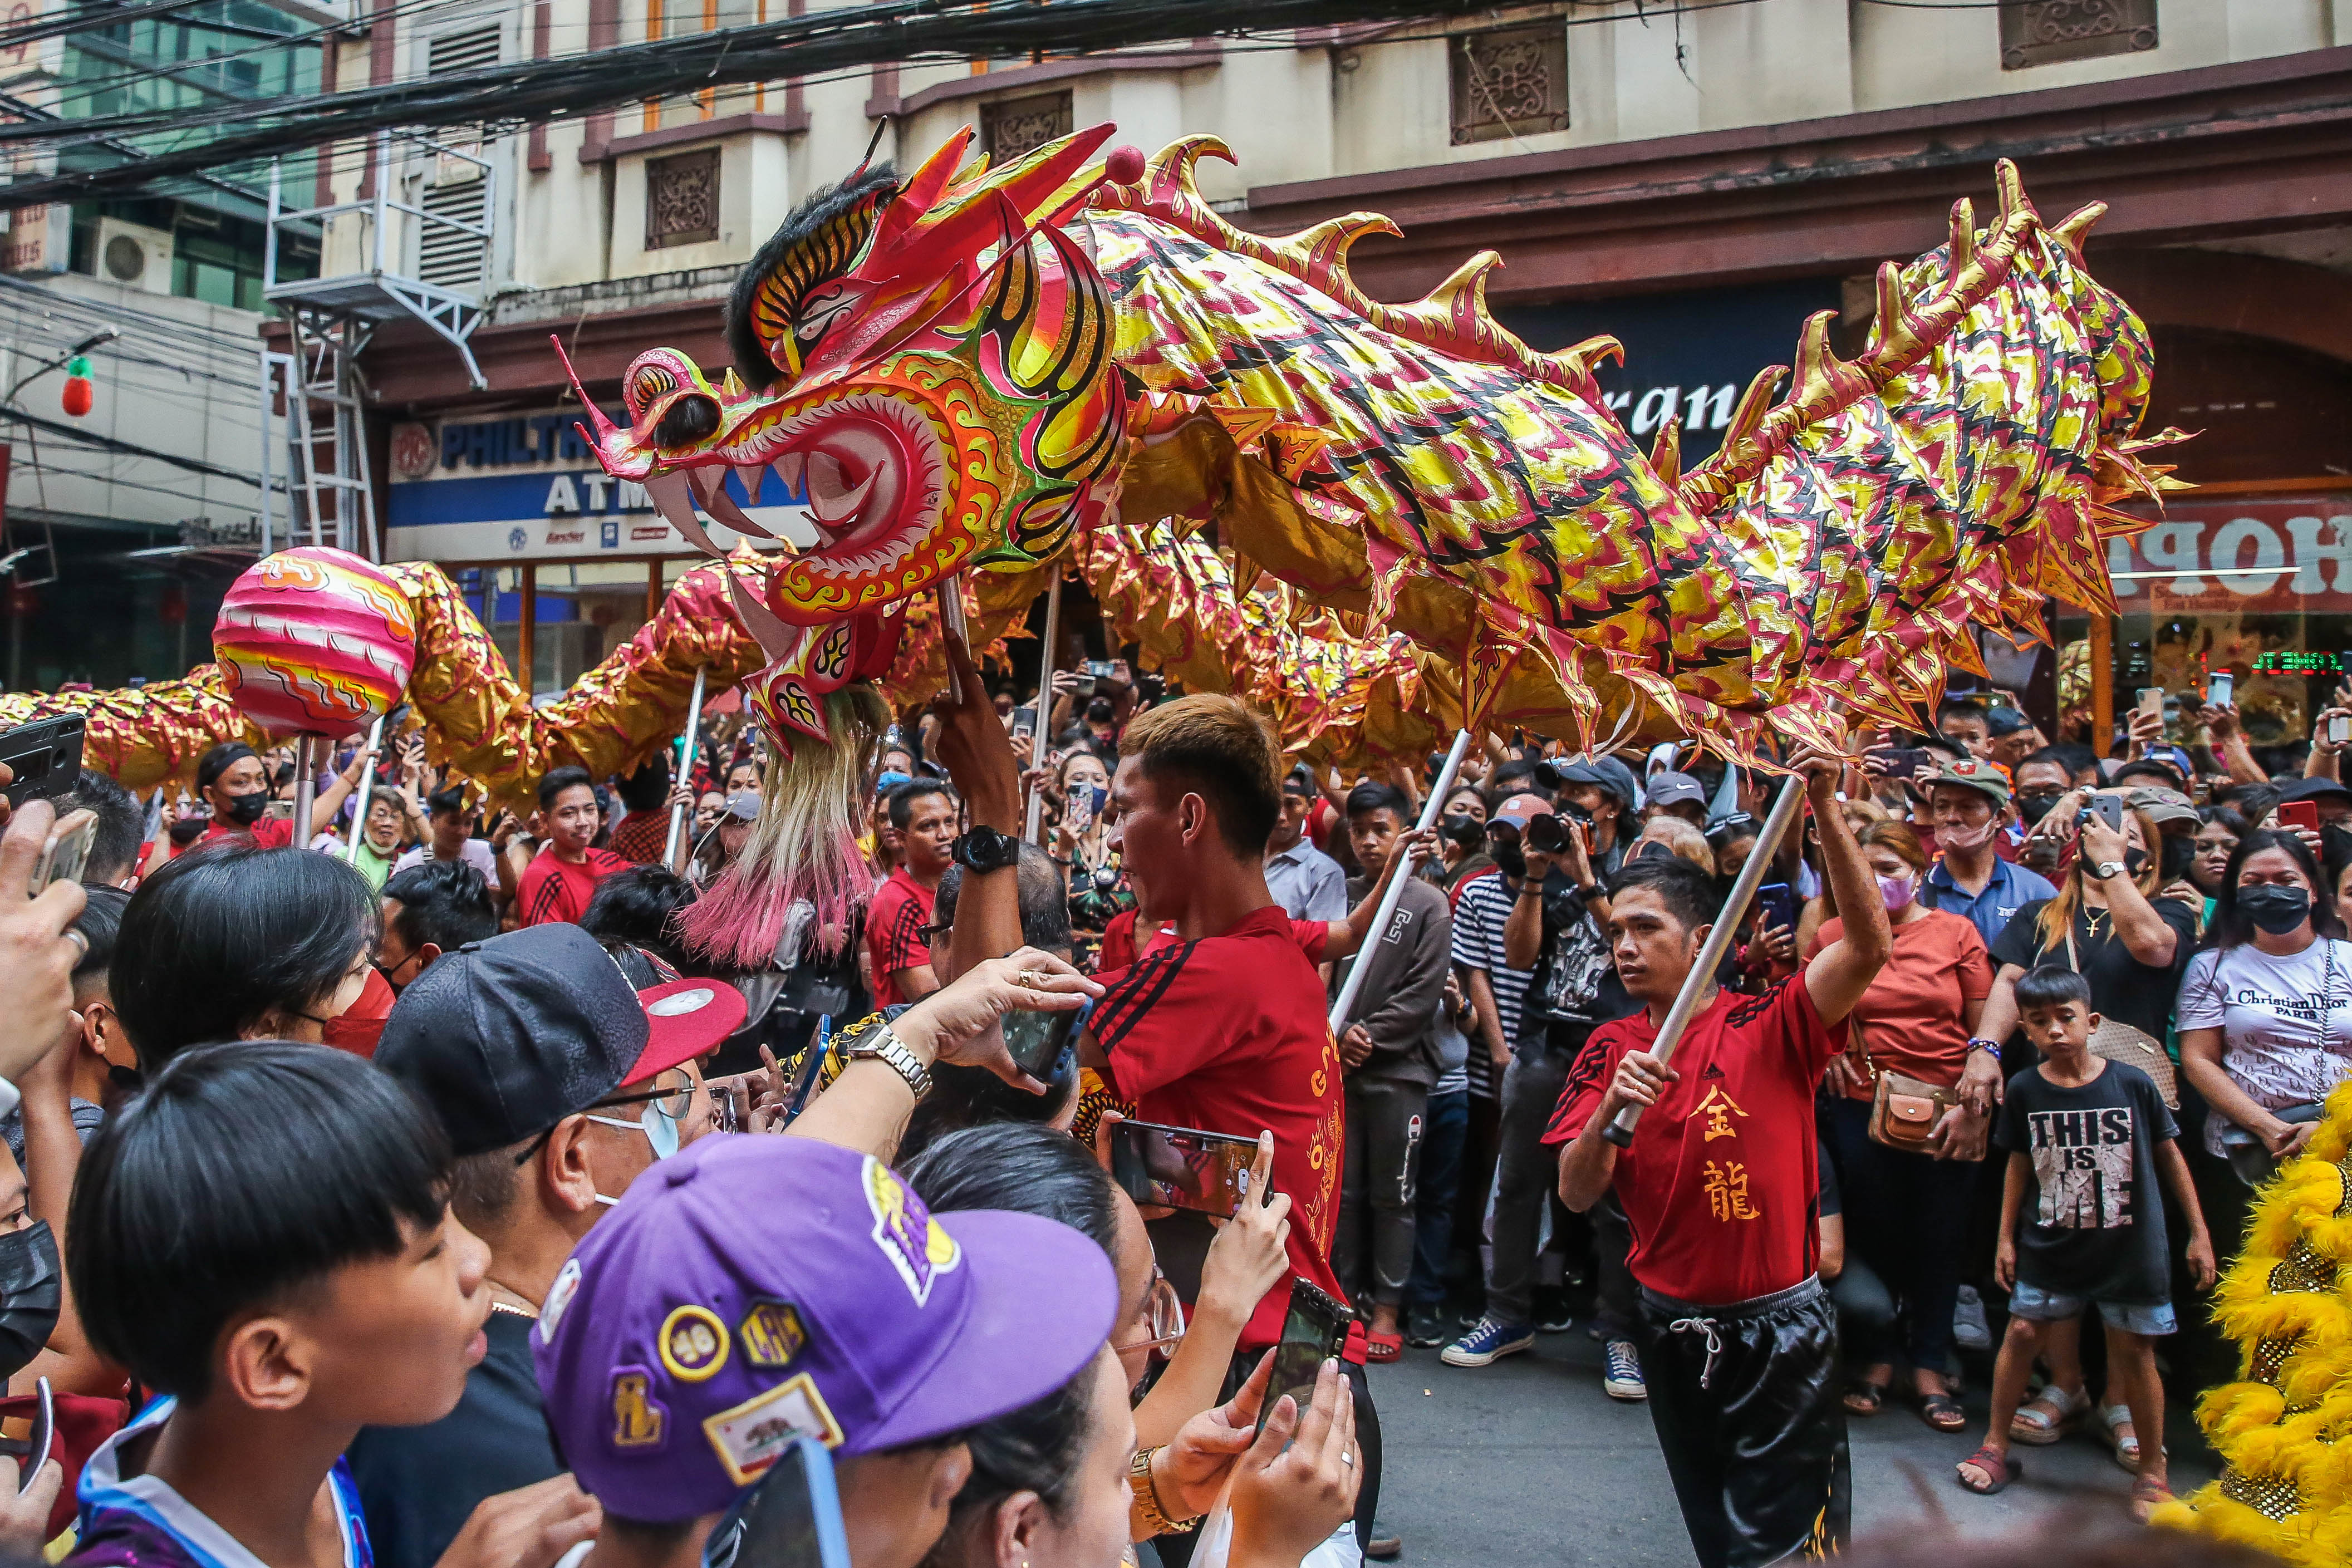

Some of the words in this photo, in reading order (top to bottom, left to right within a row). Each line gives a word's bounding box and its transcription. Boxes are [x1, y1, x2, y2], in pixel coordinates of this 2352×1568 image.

[544, 473, 654, 513] ATM
[2238, 989, 2311, 1009] Christian
[2275, 1006, 2317, 1020] PARIS
[2029, 1109, 2129, 1147] THIS
[1687, 1084, 1760, 1222] 金龍
[2063, 1147, 2097, 1170] IS
